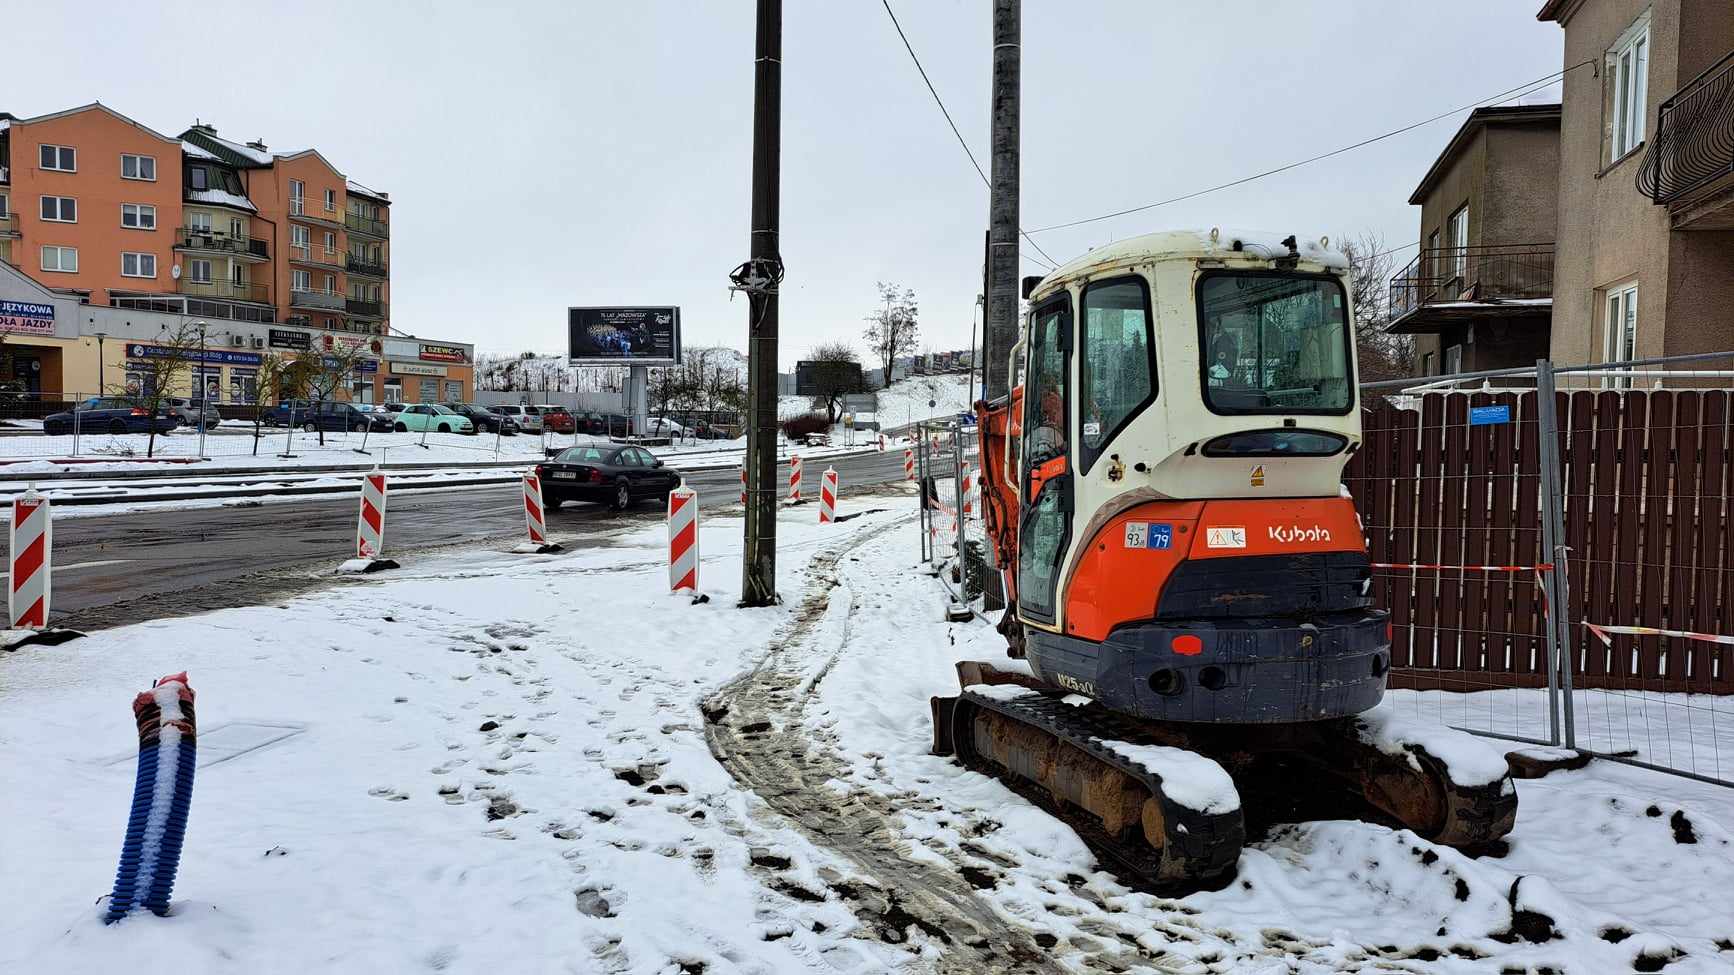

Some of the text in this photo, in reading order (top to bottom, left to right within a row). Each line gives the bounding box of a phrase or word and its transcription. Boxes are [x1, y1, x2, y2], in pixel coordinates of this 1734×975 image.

[2, 302, 52, 314] JĘZYKOWA
[20, 318, 52, 328] JAZDY
[1127, 533, 1139, 546] 93
[1268, 525, 1331, 542] Kubota
[1153, 534, 1169, 547] 79
